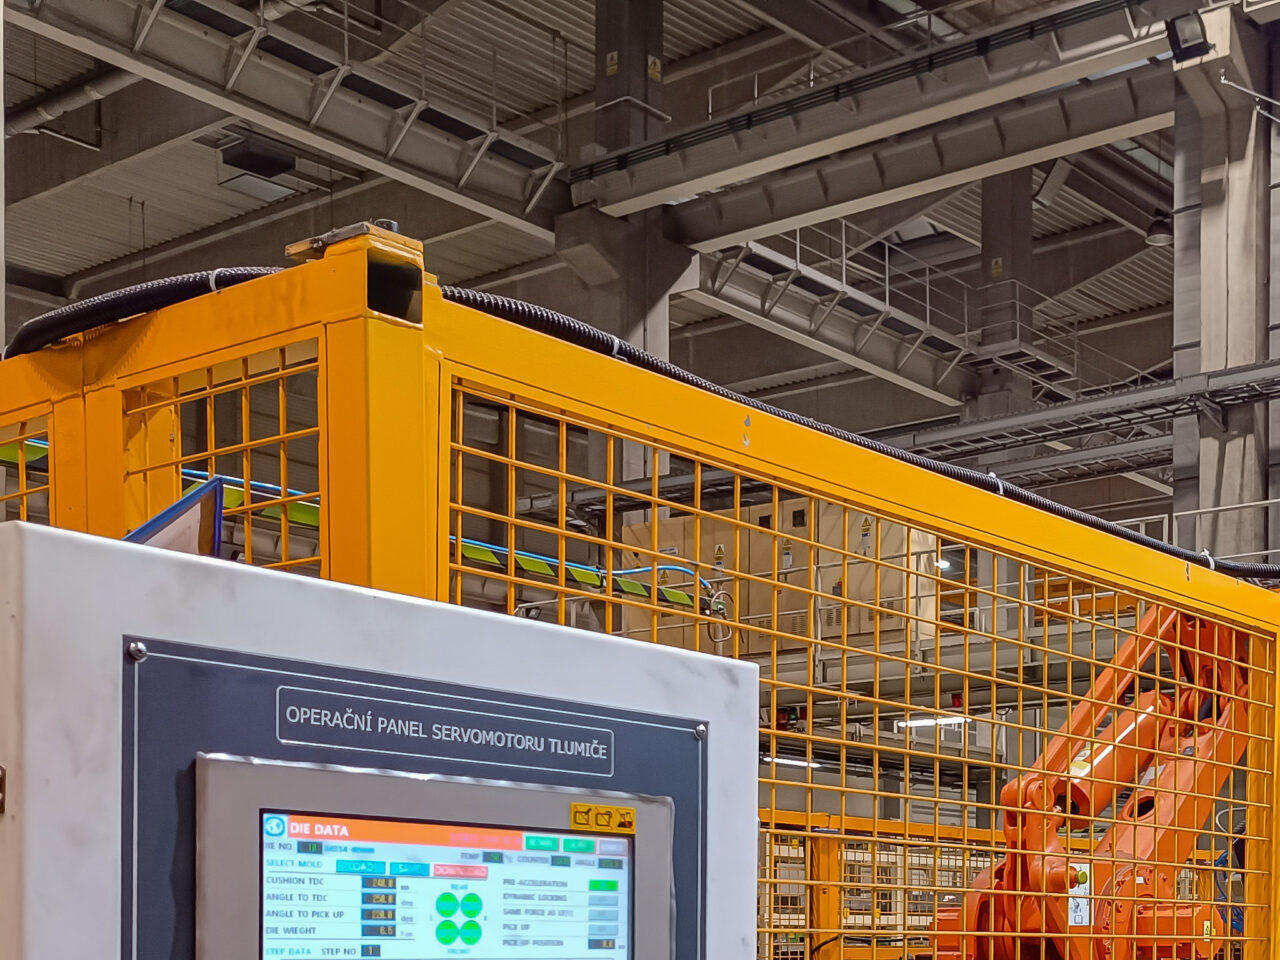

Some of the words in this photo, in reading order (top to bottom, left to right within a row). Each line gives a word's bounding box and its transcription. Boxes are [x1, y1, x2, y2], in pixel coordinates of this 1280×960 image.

[286, 705, 373, 732] OPERAČNÍ
[378, 717, 428, 739] PANEL
[432, 724, 545, 752] SERVOMOTORU
[548, 738, 607, 760] TLUMIČE
[290, 822, 310, 834] DIE
[314, 823, 349, 836] DATA
[266, 876, 305, 885] CUSHION
[308, 877, 324, 886] TDC
[266, 893, 293, 901] ANGLE
[312, 894, 328, 902] TDC
[265, 910, 293, 918] ANGLE
[297, 910, 308, 918] TO
[312, 910, 330, 918] PICK
[283, 926, 316, 934] WIEGHT
